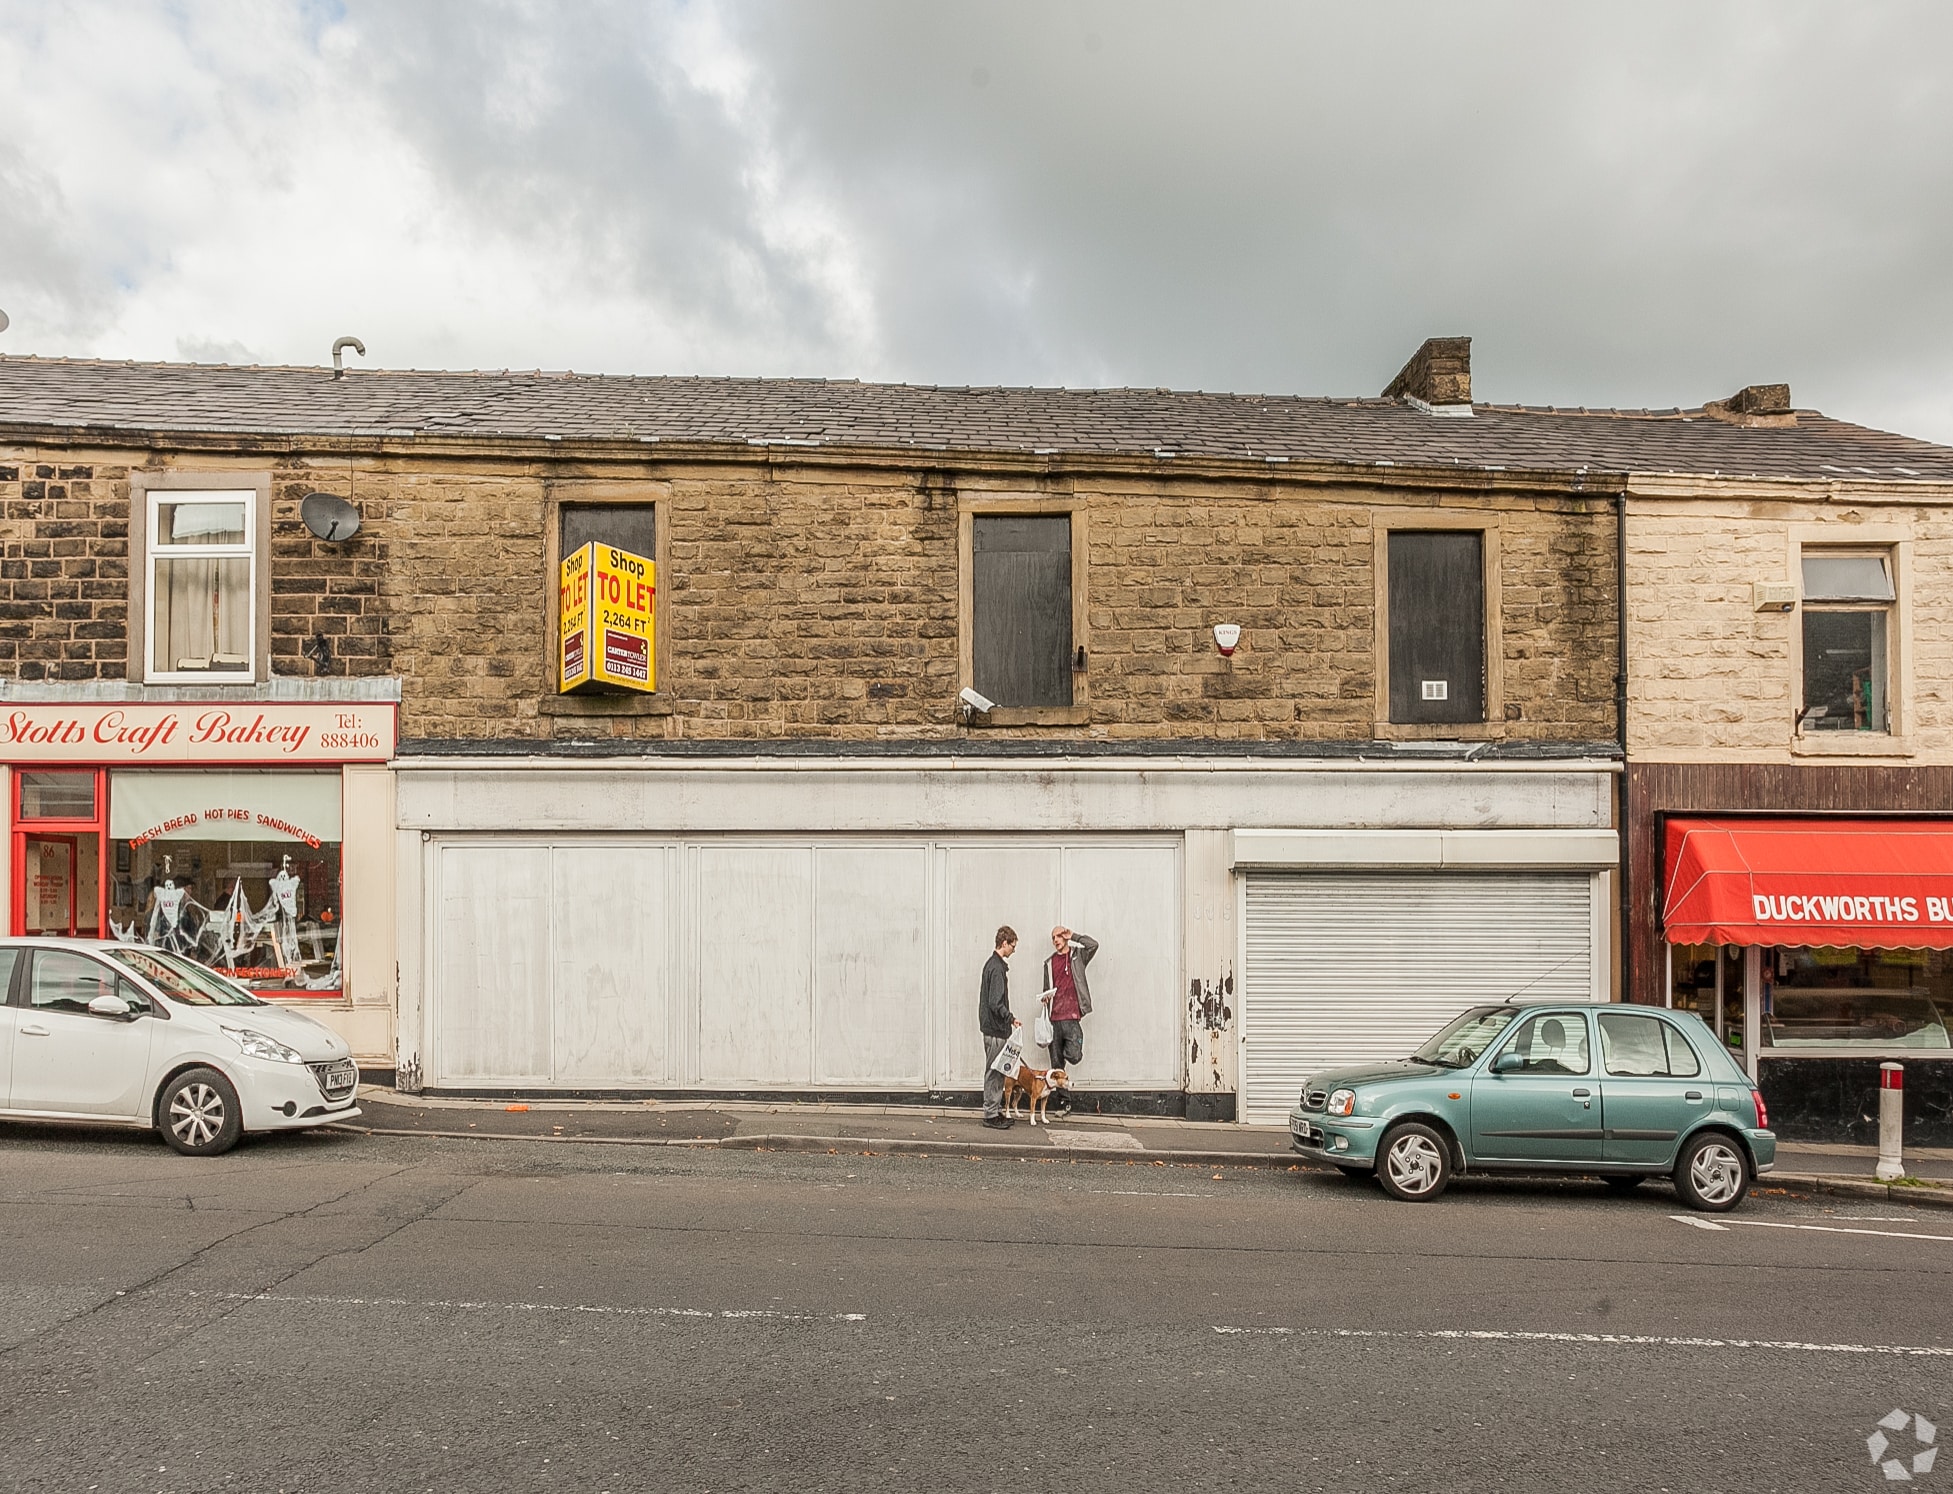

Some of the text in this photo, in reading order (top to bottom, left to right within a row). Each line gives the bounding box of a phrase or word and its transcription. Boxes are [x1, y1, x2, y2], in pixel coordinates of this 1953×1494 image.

[566, 554, 583, 577] Shop
[611, 550, 644, 580] Shop
[561, 571, 589, 615] TO LET
[597, 571, 656, 615] TO LET
[603, 610, 631, 629] 2,264
[0, 710, 311, 754] Stotts Craft Bakery
[335, 714, 362, 729] Tel:
[321, 733, 379, 748] 888406
[129, 808, 322, 850] FRESH BREAD HOT PIES SANDWICHES
[43, 845, 55, 858] 86
[1753, 894, 1953, 922] DUCKWORTHS BU
